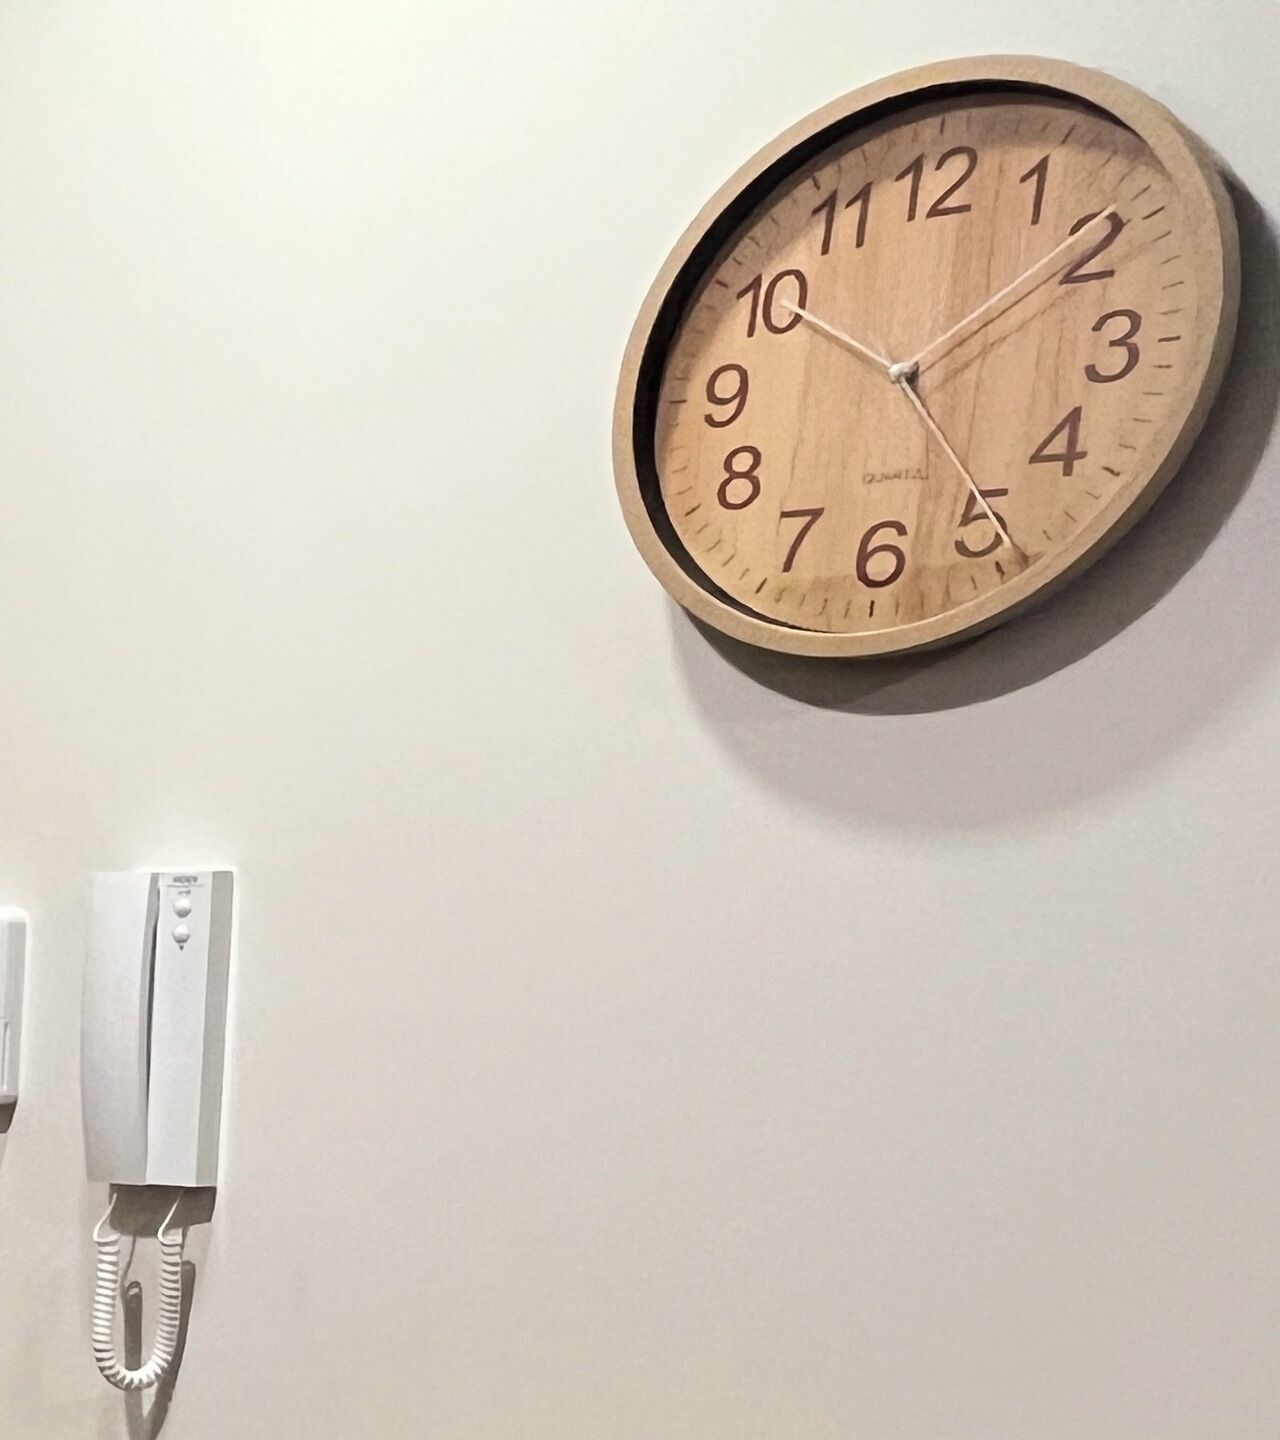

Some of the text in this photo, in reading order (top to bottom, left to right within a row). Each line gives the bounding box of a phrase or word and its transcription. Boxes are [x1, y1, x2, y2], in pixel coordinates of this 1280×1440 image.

[810, 180, 874, 256] 11
[894, 145, 979, 223] 12
[1018, 153, 1051, 226] 1
[1058, 208, 1127, 286] 2
[735, 268, 809, 339] 10
[1083, 308, 1143, 384] 3
[703, 363, 750, 429] 9
[1028, 405, 1089, 477] 4
[716, 445, 762, 511] 8
[779, 506, 825, 574] 7
[855, 519, 908, 589] 6
[954, 487, 1009, 558] 5
